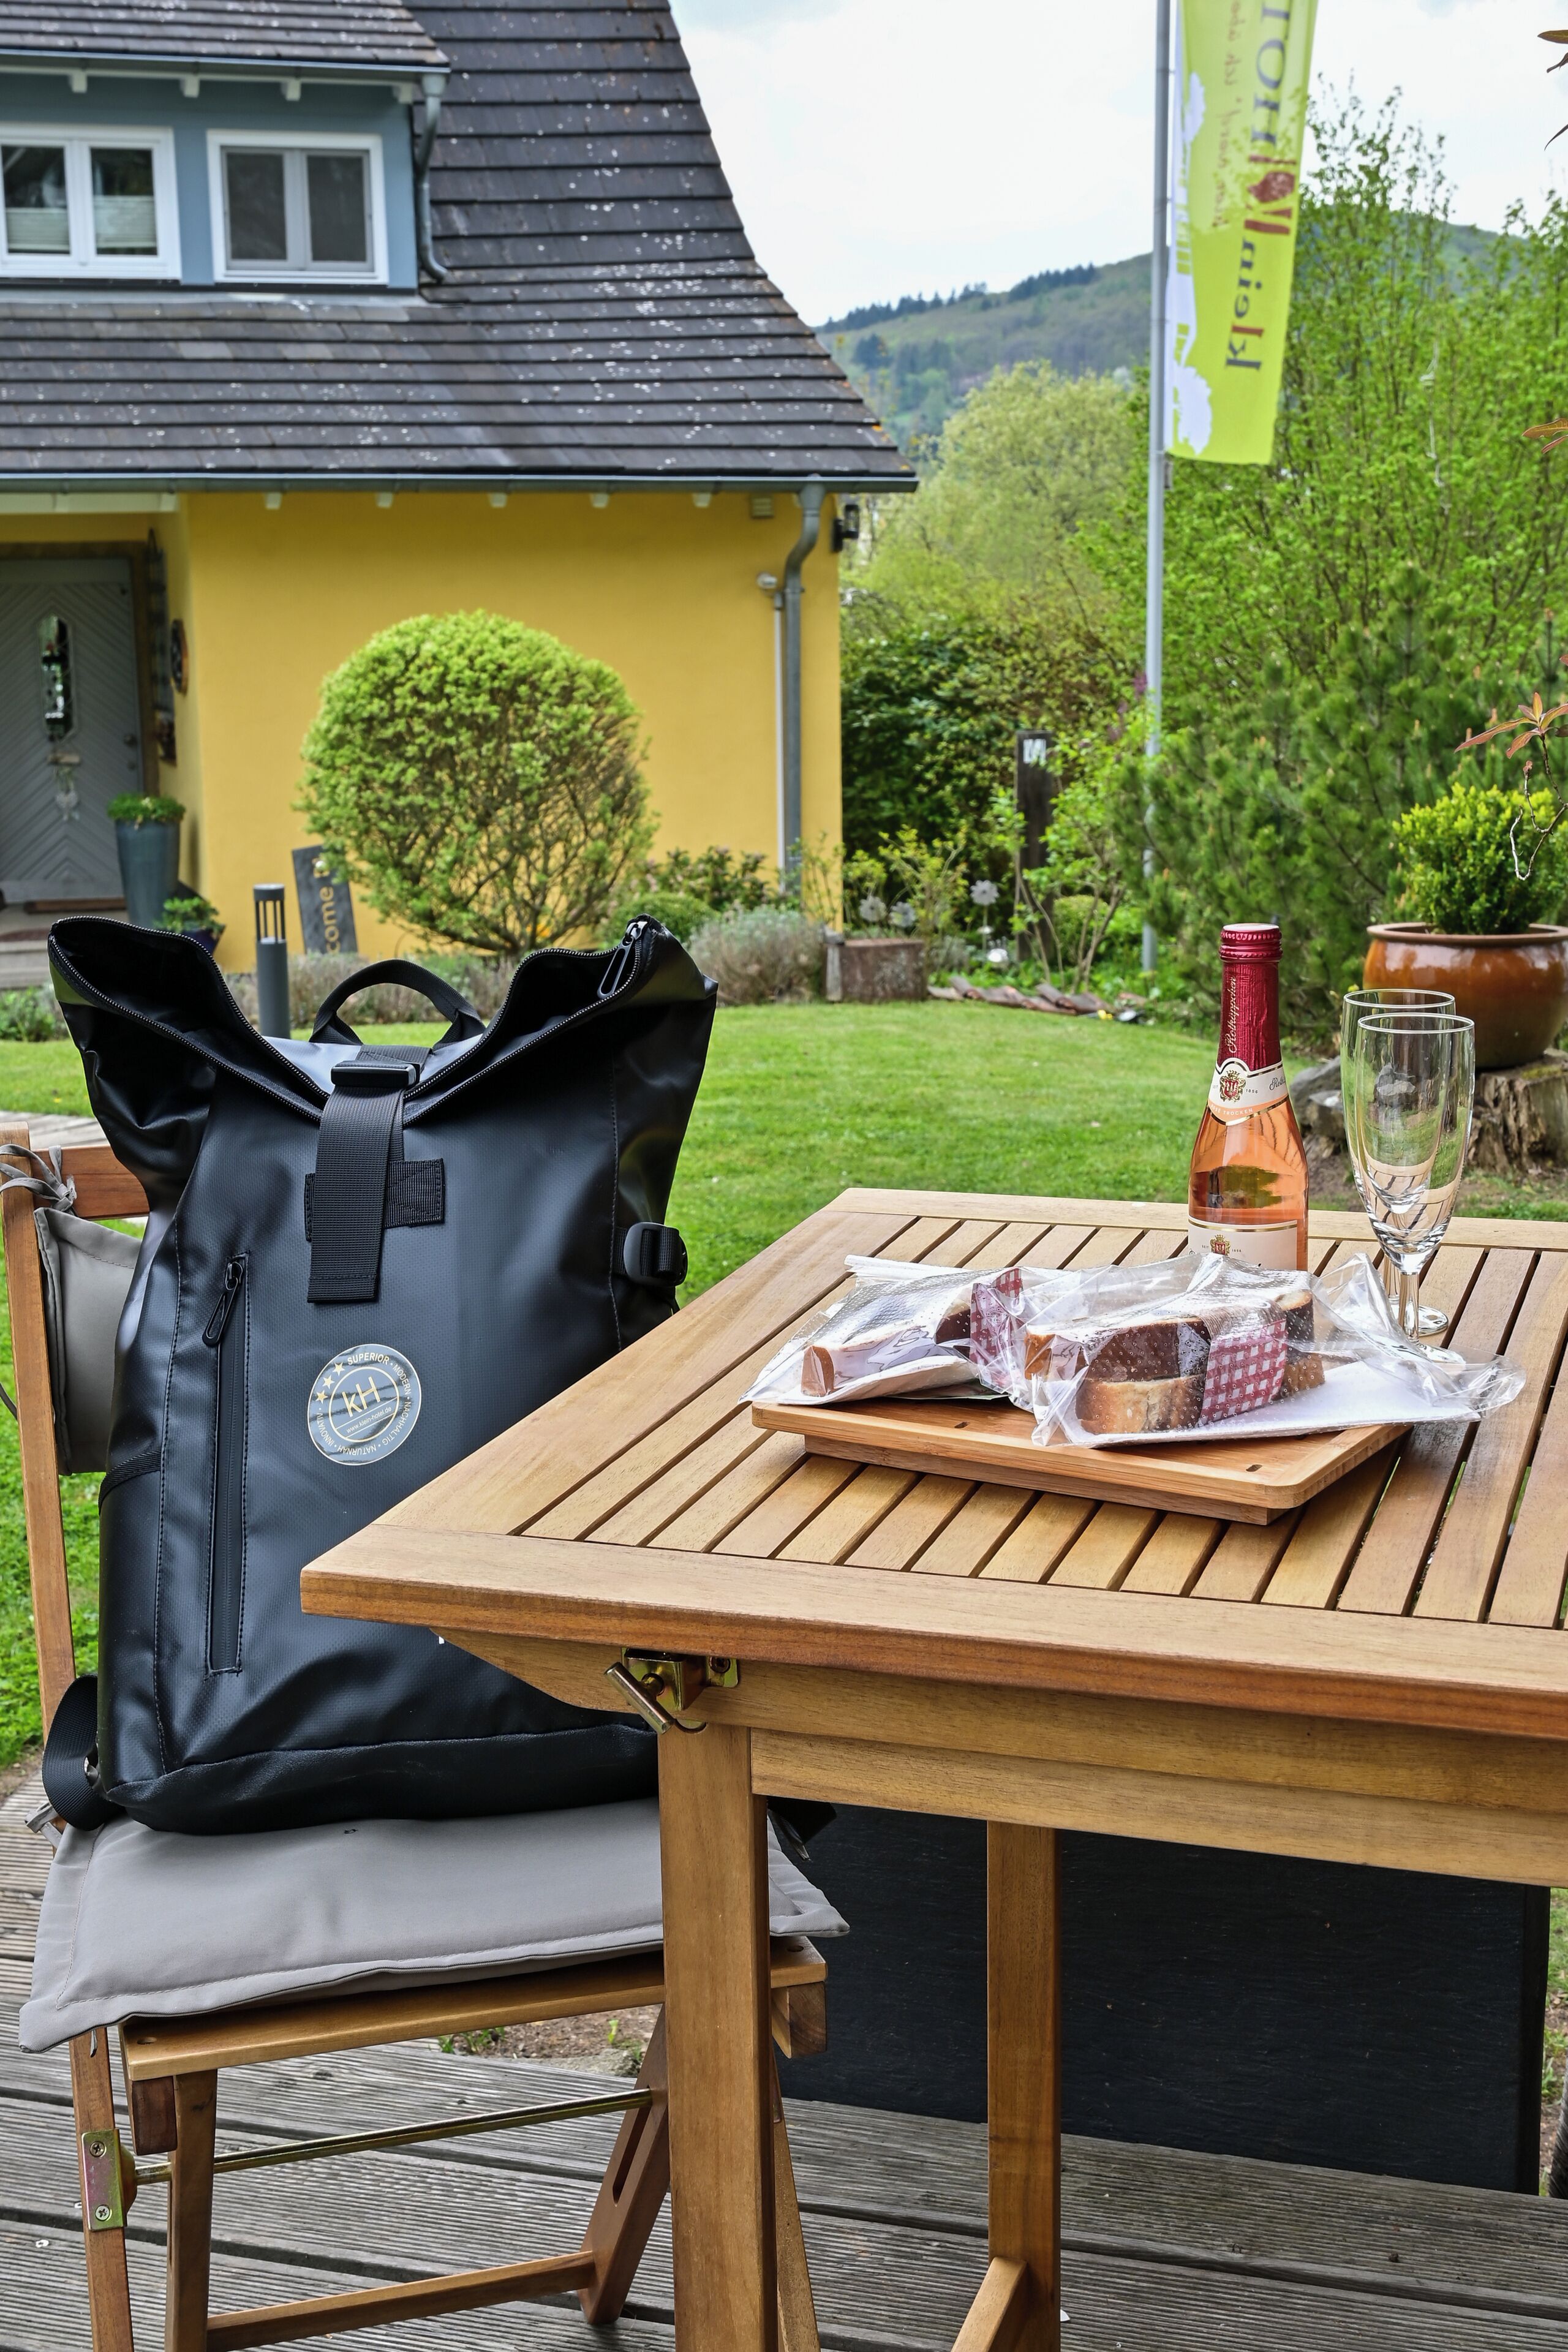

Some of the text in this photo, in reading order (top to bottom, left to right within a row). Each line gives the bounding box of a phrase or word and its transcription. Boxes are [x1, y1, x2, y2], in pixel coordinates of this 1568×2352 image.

[316, 1352, 412, 1456] SUPERIOR MODERN NACHHALTIG NATURNAH INNOVATIV
[346, 1406, 392, 1434] www.klein-hotel.de
